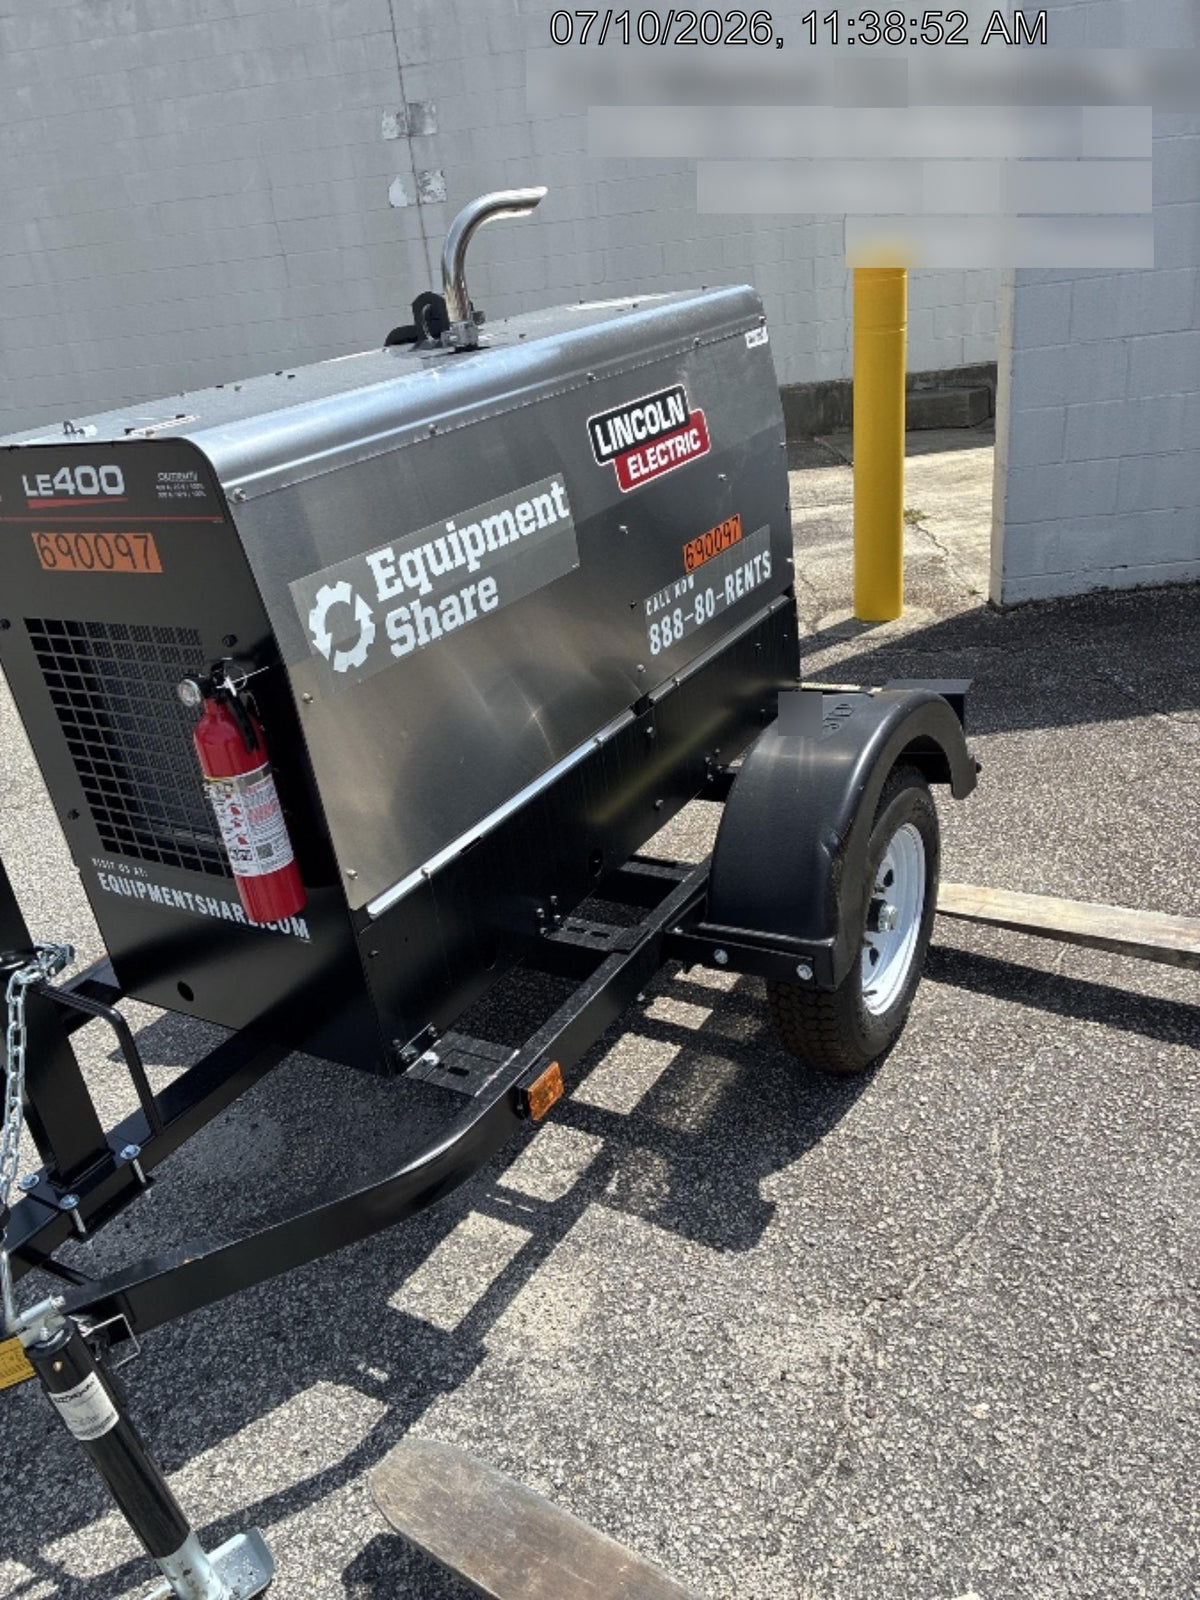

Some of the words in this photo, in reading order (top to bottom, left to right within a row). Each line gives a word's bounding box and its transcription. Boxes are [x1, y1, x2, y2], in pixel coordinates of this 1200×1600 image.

[594, 393, 686, 456] LINCOLN
[626, 427, 701, 480] ELECTRIC
[22, 465, 125, 497] LE400
[36, 533, 151, 570] 690097
[365, 481, 570, 602] Equipment
[685, 516, 739, 569] 690097
[385, 575, 499, 658] Share
[646, 591, 672, 616] CALL
[649, 550, 773, 655] 888-80-RENTS
[98, 872, 310, 939] EQUIPMENTSHAR.OM
